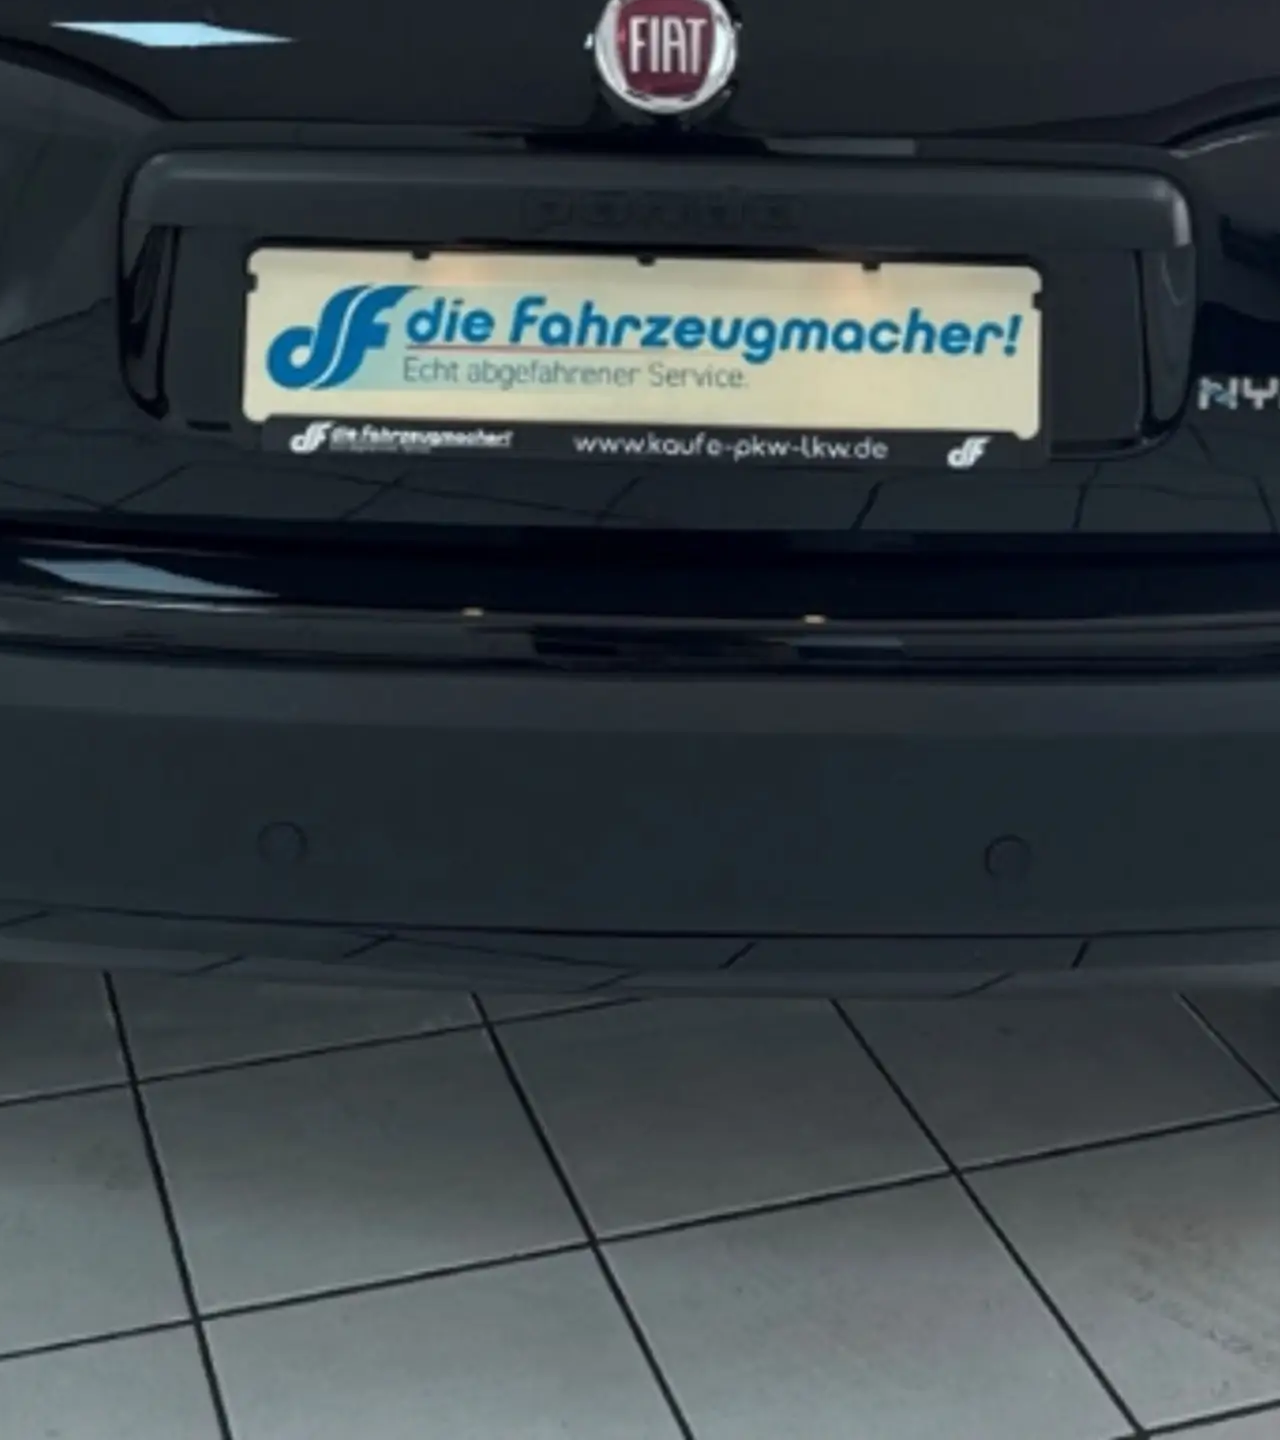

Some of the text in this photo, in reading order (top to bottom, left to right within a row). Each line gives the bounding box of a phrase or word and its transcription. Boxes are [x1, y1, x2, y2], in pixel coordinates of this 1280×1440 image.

[628, 15, 708, 76] FIAT
[405, 295, 1023, 365] die Fahrzeugmacher!
[402, 357, 751, 391] Echt abgefahrener Service.
[572, 431, 889, 462] www.kaufe-pkw-lkw.de
